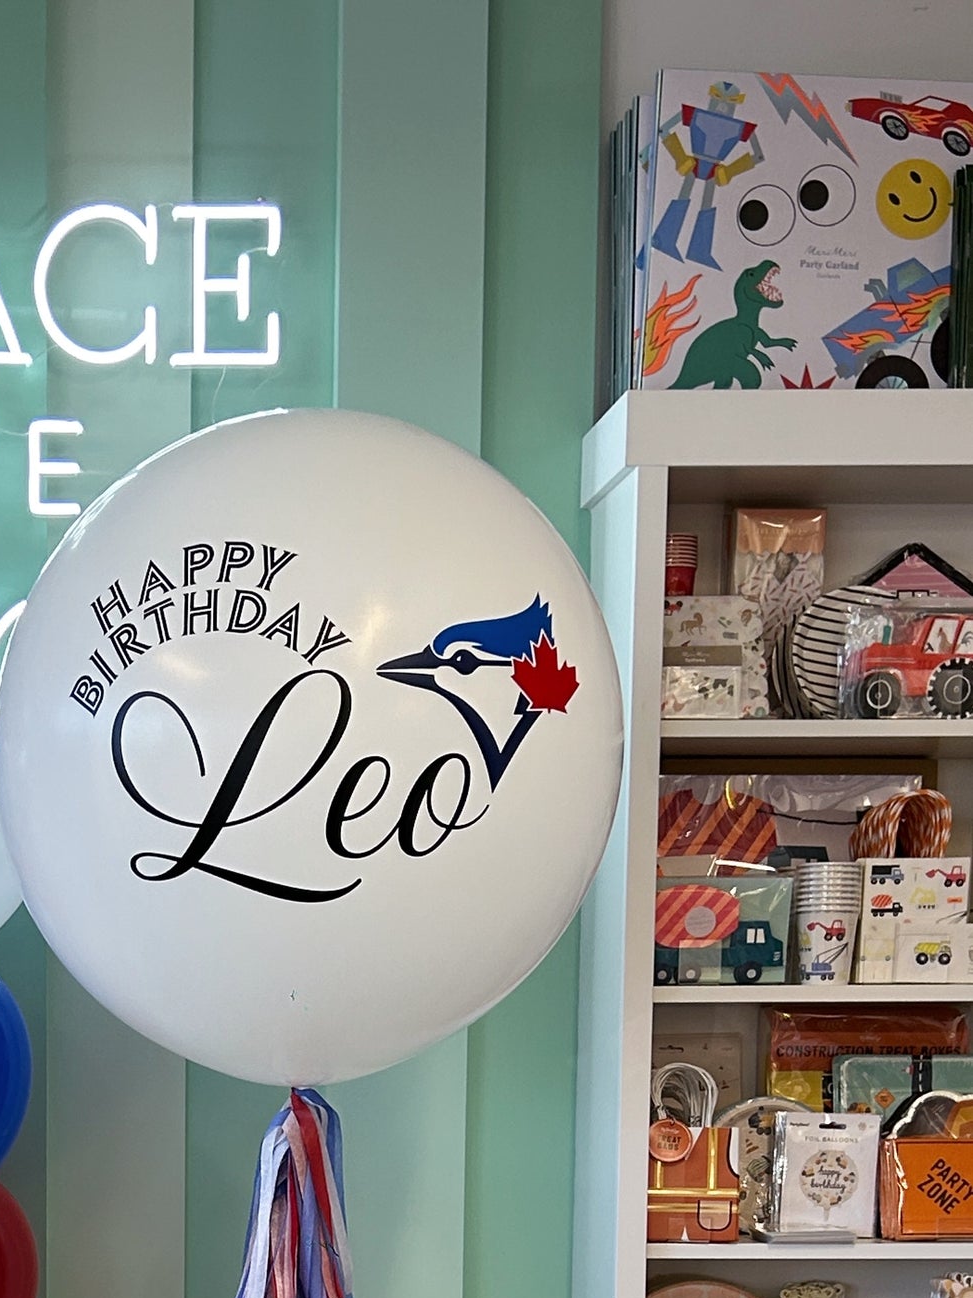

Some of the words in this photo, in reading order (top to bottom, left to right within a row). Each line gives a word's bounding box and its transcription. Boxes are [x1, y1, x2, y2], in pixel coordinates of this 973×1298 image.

[800, 259, 823, 269] Party
[826, 261, 859, 270] Garland
[90, 541, 298, 636] HAPPY
[69, 588, 352, 717] BIRTHDAY
[111, 669, 490, 904] Leo
[777, 1044, 873, 1057] CONSTRUCTION
[878, 1044, 915, 1055] TREAT
[920, 1044, 961, 1055] BOXES
[657, 1134, 682, 1144] TREAT
[810, 1178, 847, 1194] birthday
[818, 1165, 842, 1180] happy
[930, 1158, 973, 1201] PARTY
[917, 1173, 961, 1214] ZONE
